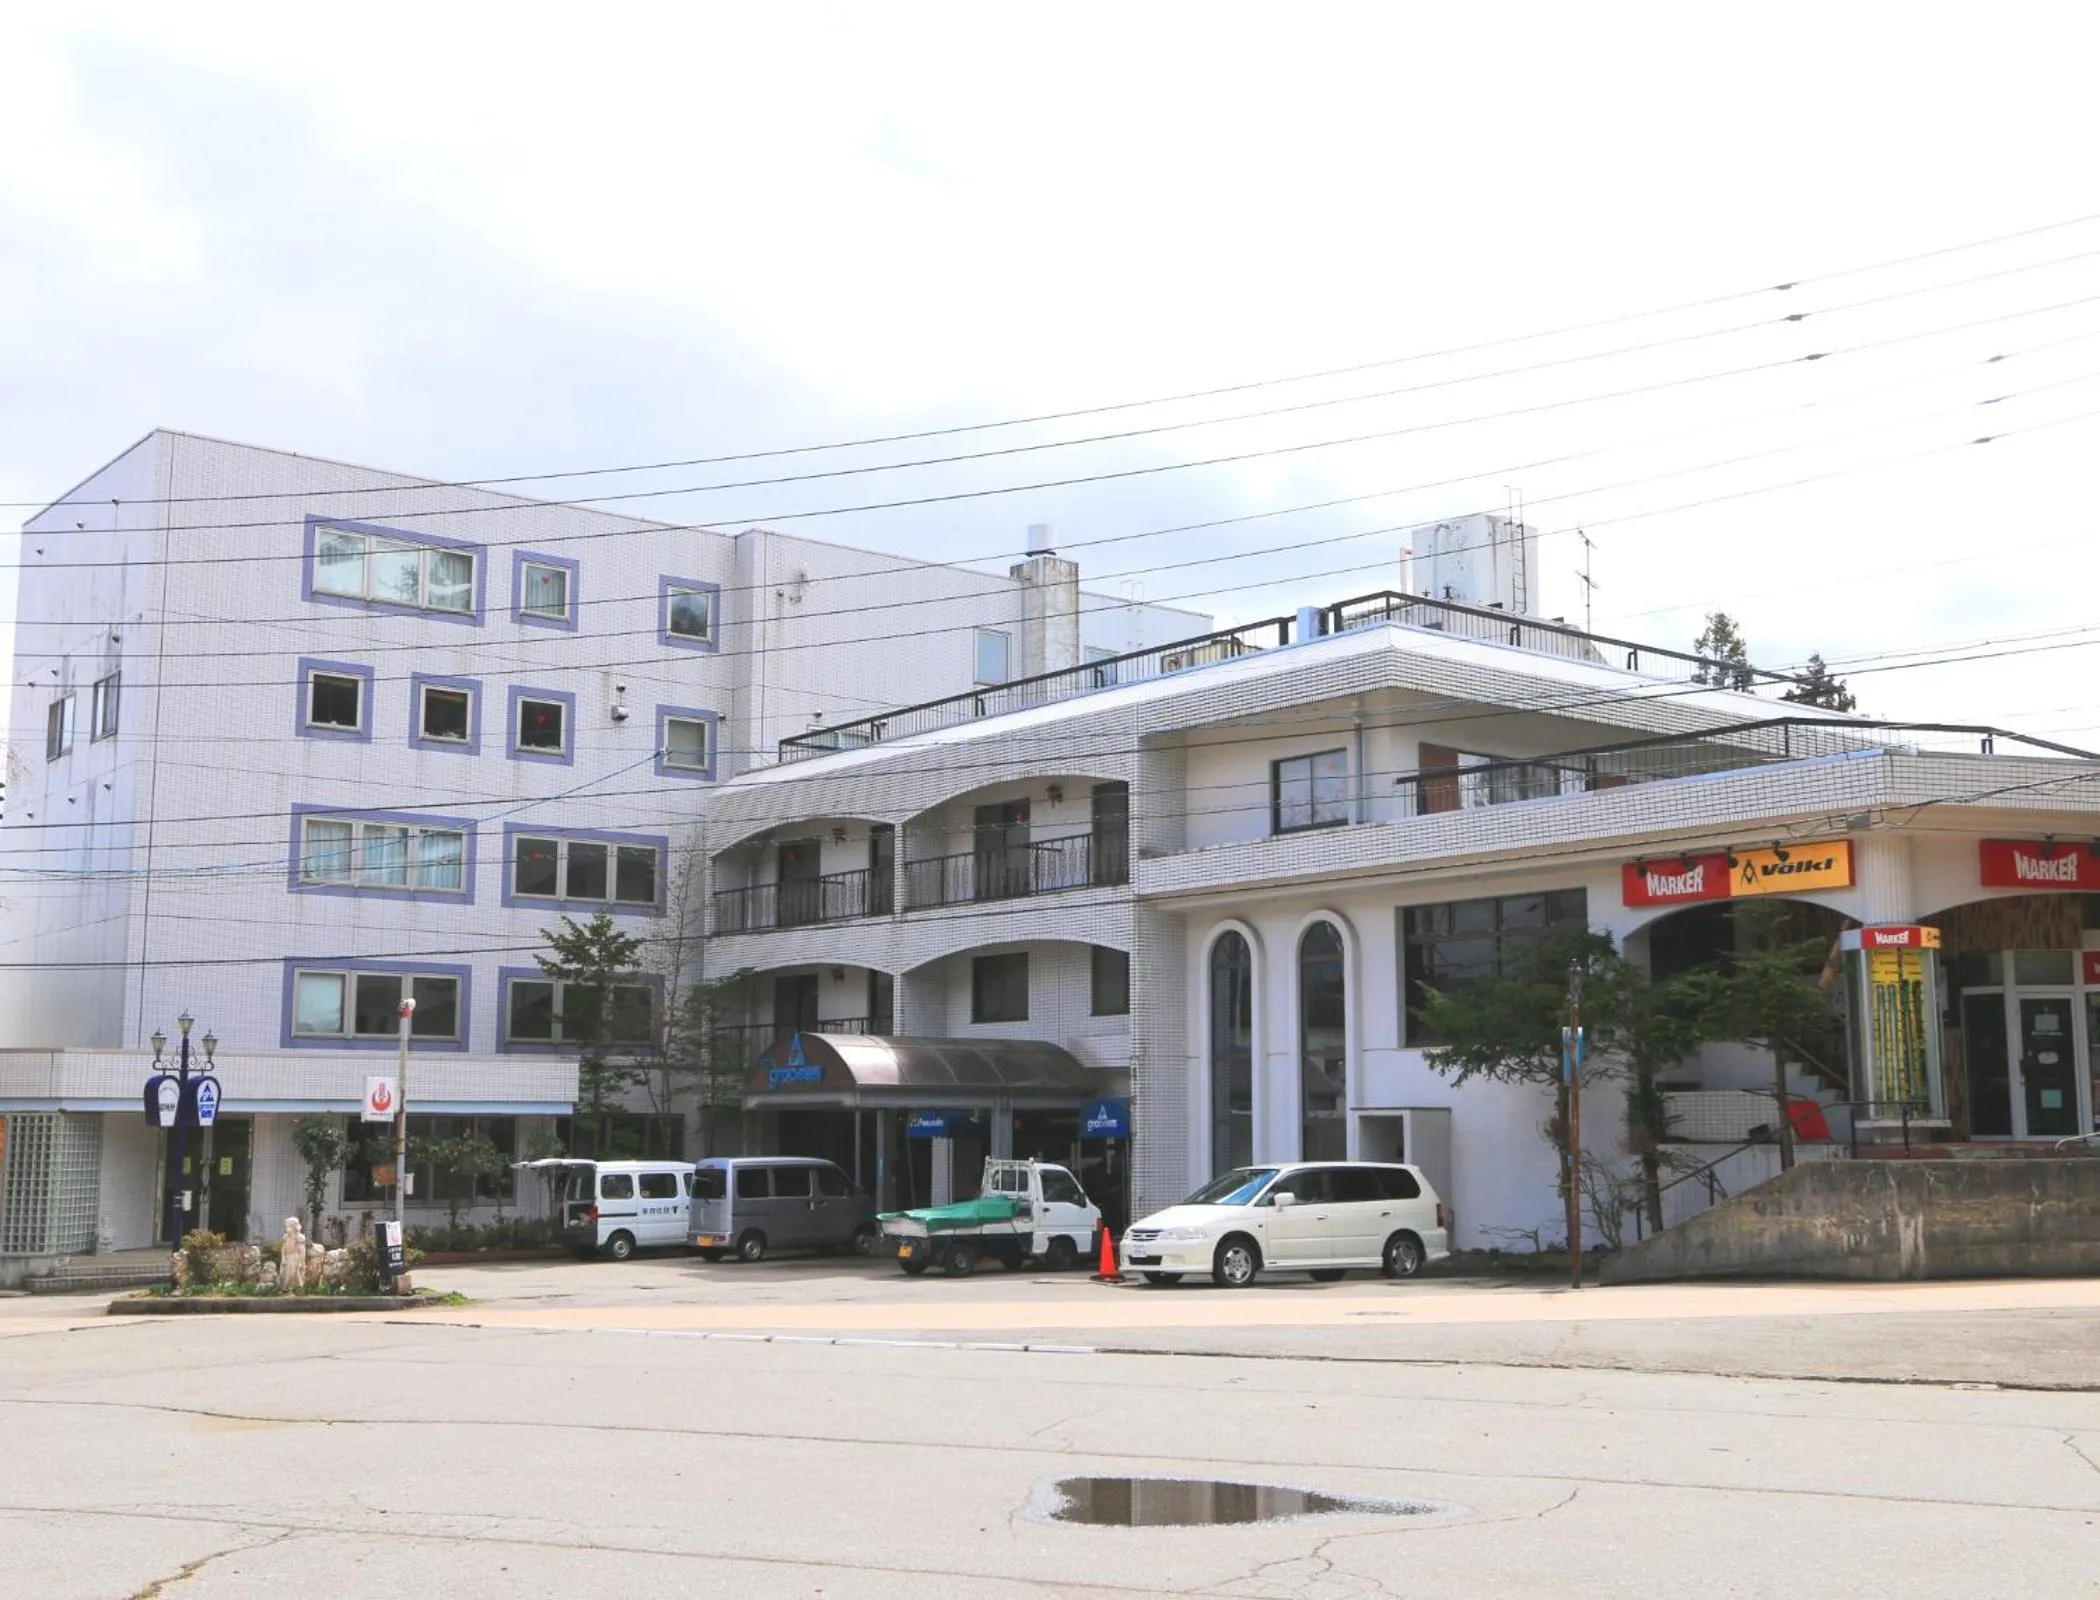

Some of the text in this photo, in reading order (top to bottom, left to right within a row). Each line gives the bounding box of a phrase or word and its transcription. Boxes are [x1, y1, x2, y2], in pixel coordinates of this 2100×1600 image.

[1646, 865, 1704, 897] MARKER
[2013, 849, 2078, 882] MARKER
[1875, 930, 1910, 945] MARKER
